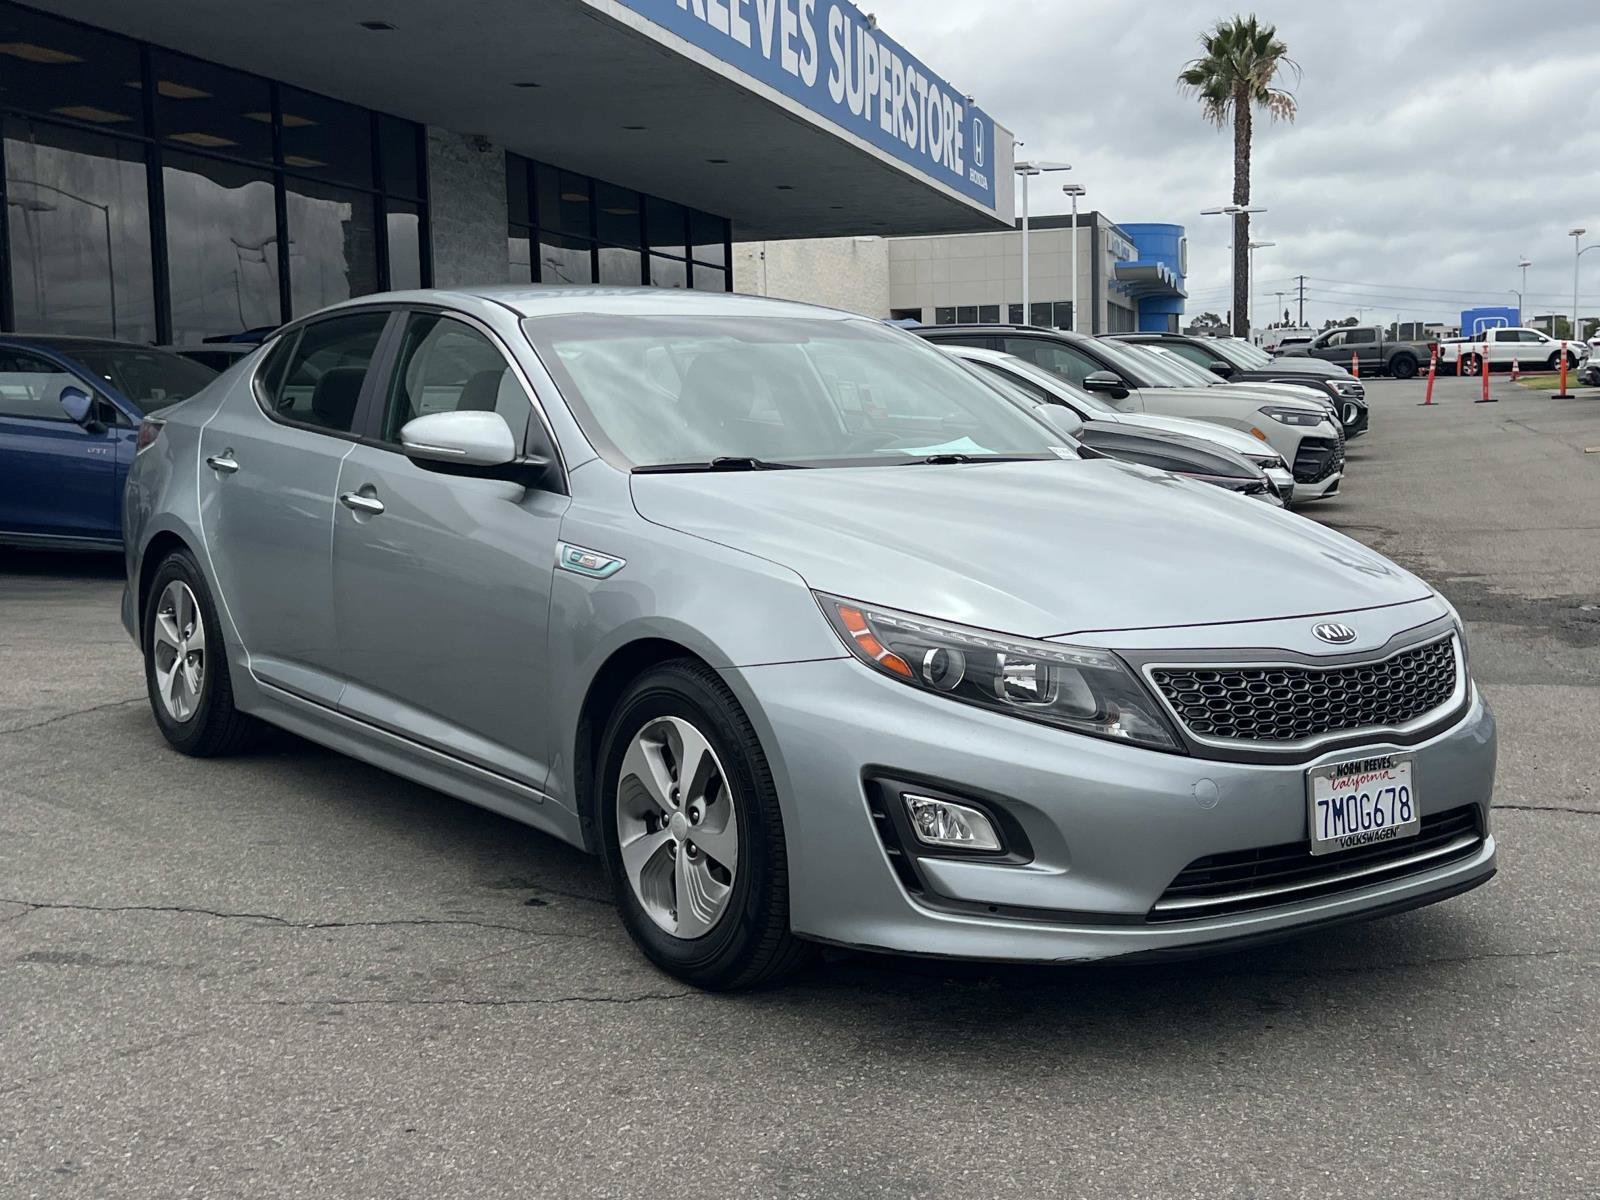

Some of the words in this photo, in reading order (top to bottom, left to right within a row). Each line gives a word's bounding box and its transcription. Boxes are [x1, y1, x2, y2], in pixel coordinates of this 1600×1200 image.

[676, 0, 818, 87] VES
[828, 4, 964, 176] SUPERSTORE
[1318, 623, 1354, 639] KIA
[1336, 760, 1362, 777] NORM
[1364, 756, 1392, 771] REEVES
[1330, 769, 1396, 792] California
[1317, 785, 1411, 838] 7MOG678
[1339, 826, 1398, 848] VOLKSWAGEN
